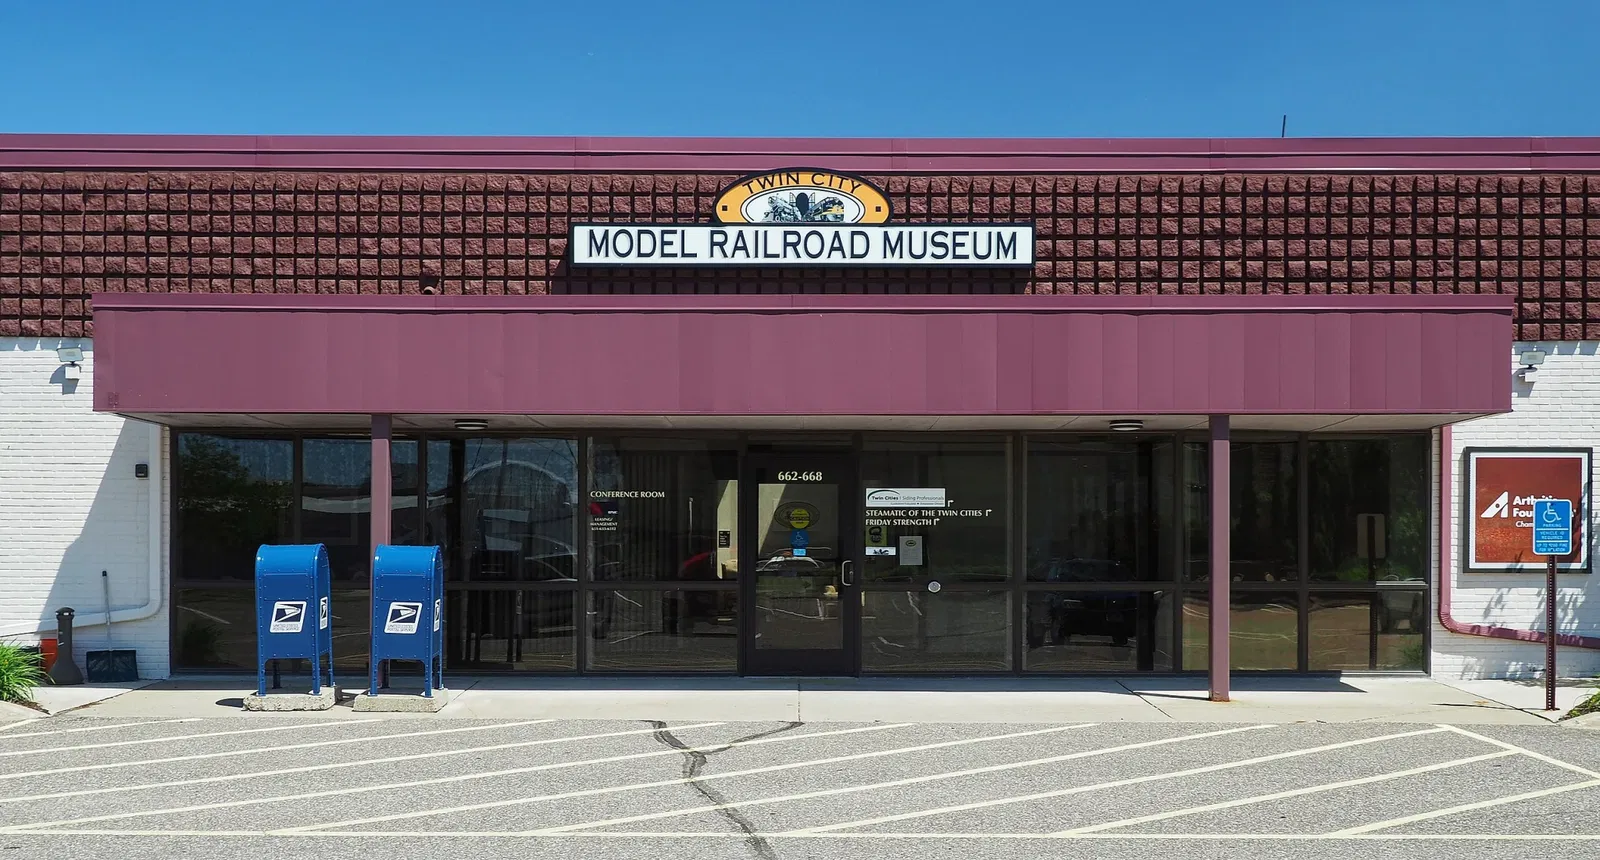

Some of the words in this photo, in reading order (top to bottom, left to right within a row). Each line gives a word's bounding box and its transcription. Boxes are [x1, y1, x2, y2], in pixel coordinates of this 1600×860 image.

[742, 172, 800, 195] TWIN
[811, 172, 862, 194] CITY
[588, 228, 698, 258] MODEL
[709, 229, 870, 259] RAILROAD
[883, 230, 1017, 260] MUSEUM
[777, 471, 823, 482] 662-668
[865, 509, 907, 517] STEAMATIC
[908, 509, 919, 517] OF
[921, 509, 936, 517] THE
[938, 509, 958, 517] TWIN
[960, 509, 983, 517] CITIES
[865, 518, 892, 526] FRIDAY
[893, 518, 932, 526] STRENGTH
